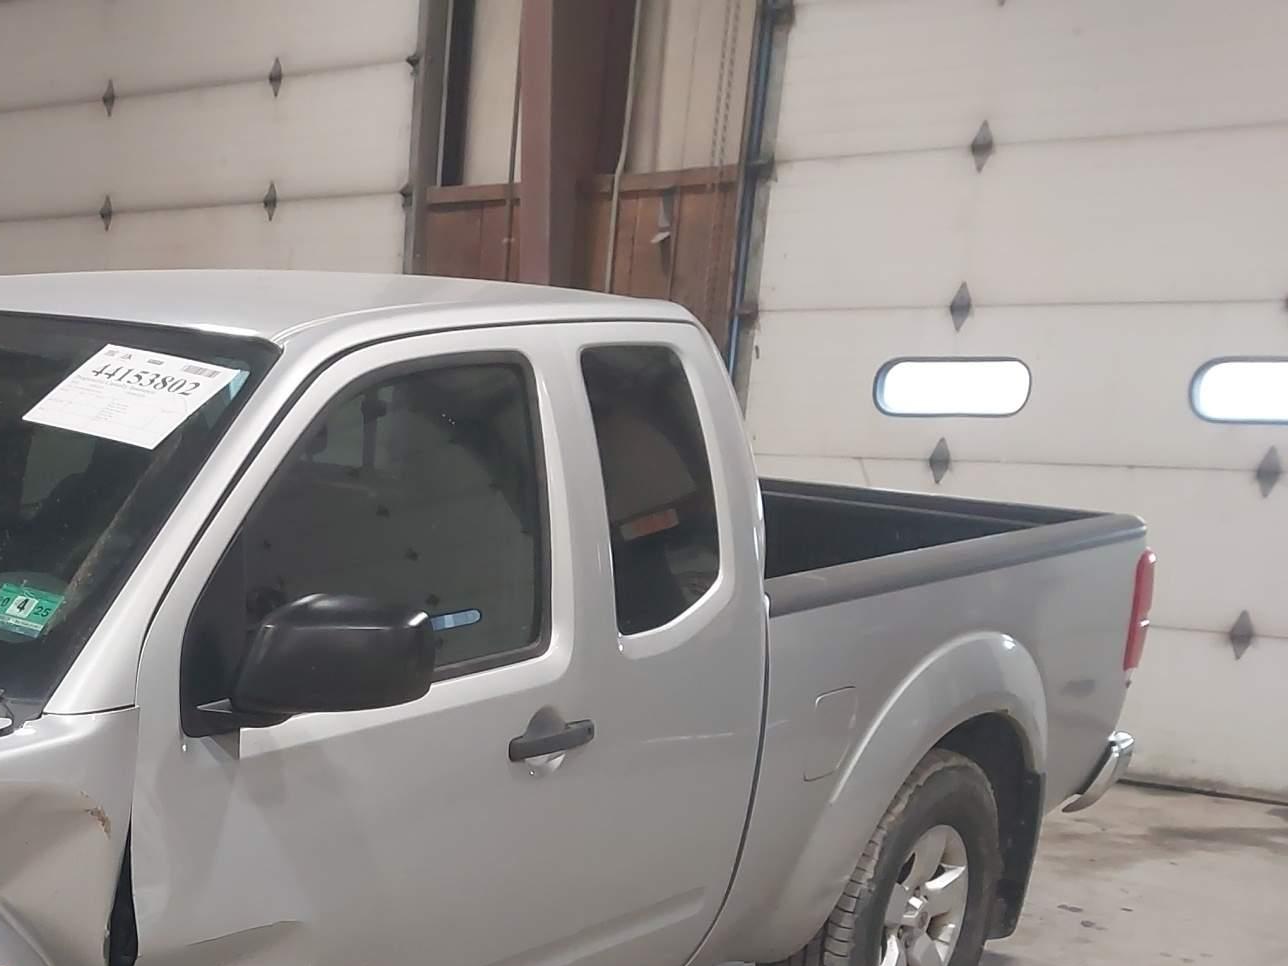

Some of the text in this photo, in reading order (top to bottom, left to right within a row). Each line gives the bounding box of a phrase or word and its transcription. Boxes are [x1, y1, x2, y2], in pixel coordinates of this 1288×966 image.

[92, 363, 201, 396] 44153802
[17, 599, 29, 612] 4
[33, 606, 52, 617] 25
